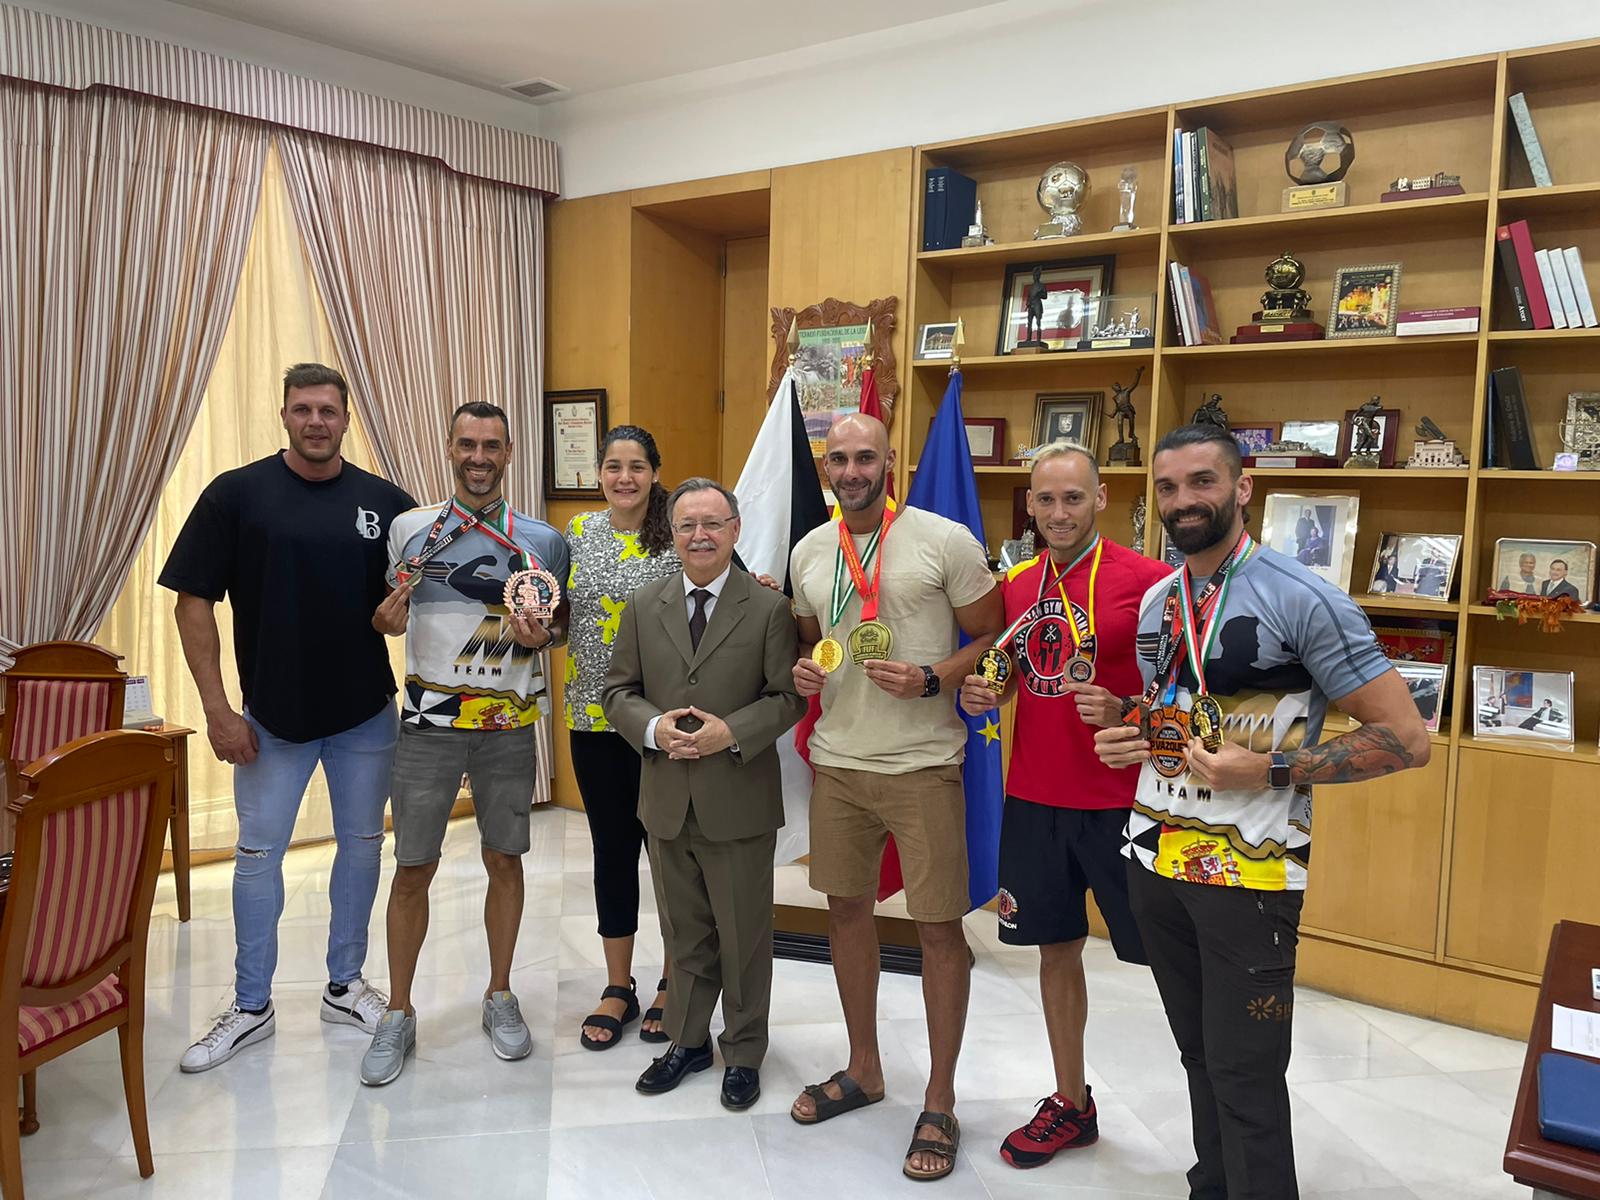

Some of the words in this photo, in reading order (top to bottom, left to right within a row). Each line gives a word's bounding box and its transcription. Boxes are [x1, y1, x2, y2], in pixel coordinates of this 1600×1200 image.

[516, 607, 549, 615] WRLD
[1016, 606, 1042, 644] SPTAN
[1043, 601, 1063, 614] GYM
[453, 664, 502, 677] TEAM
[1155, 779, 1212, 803] TEAM
